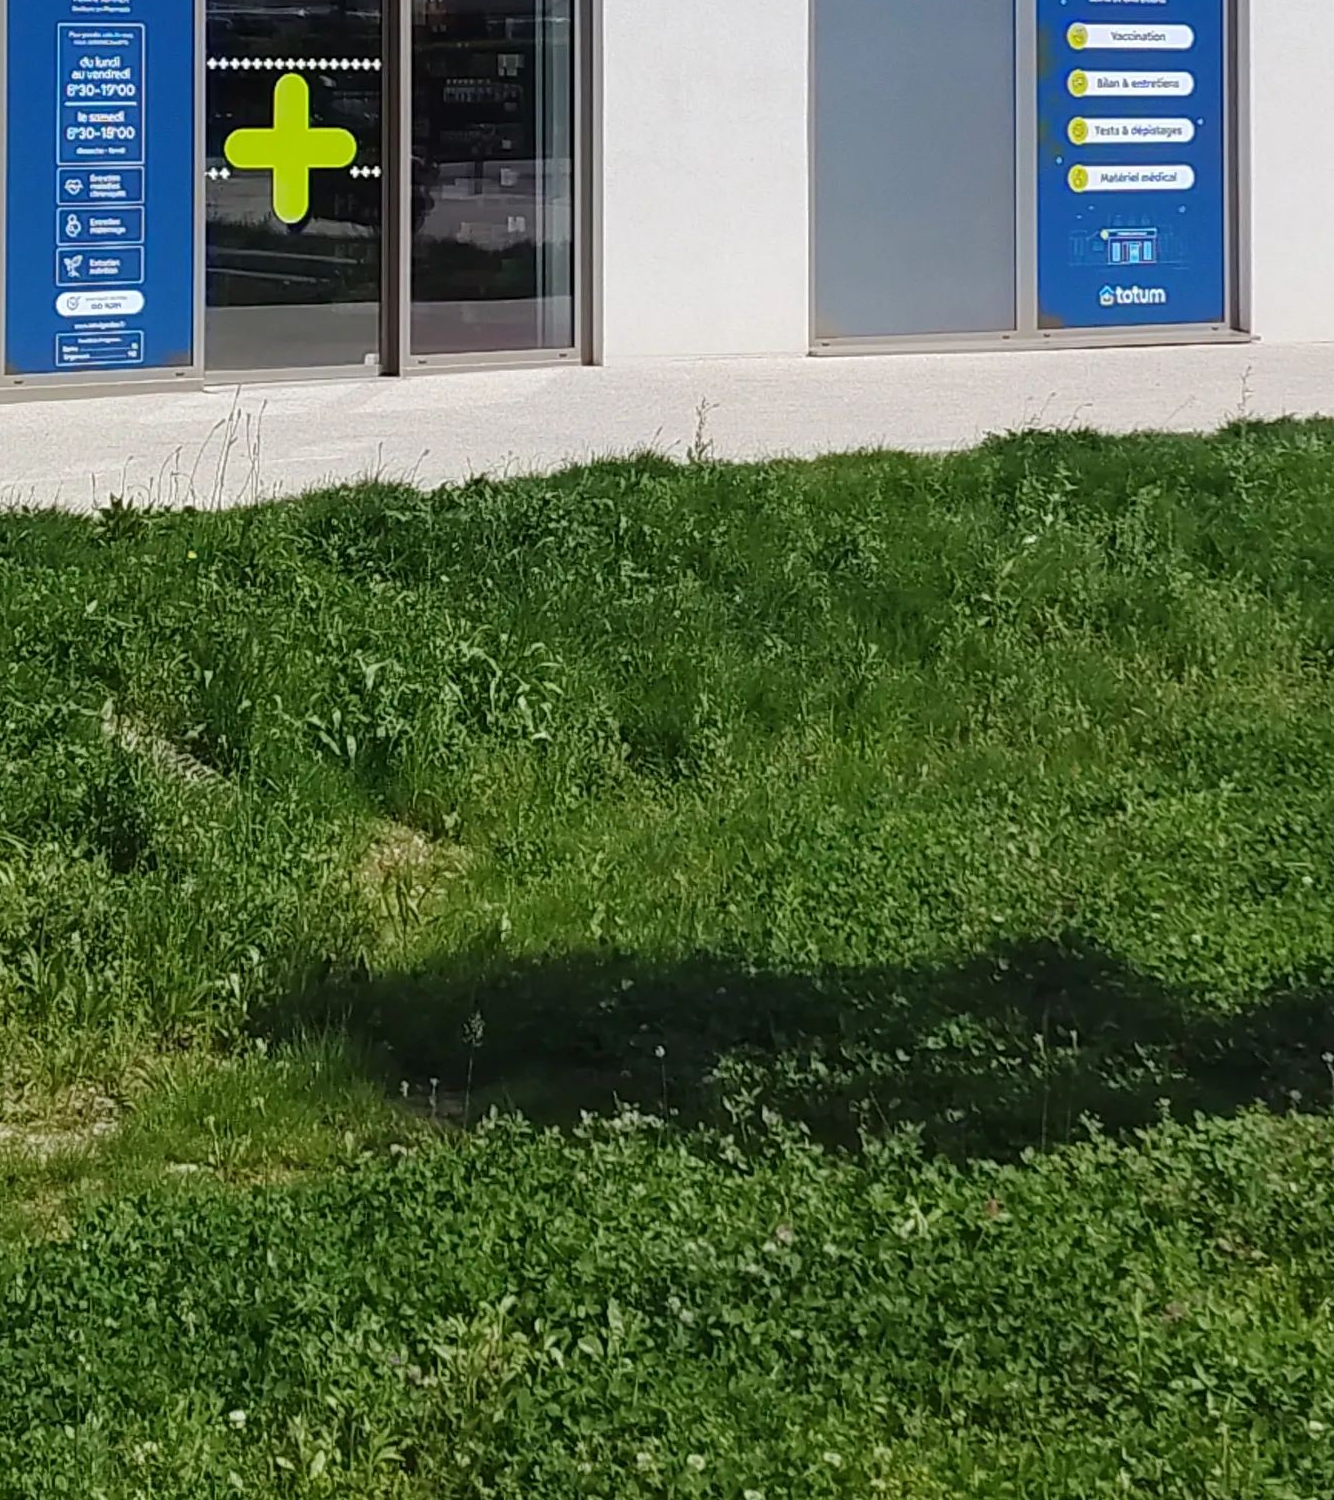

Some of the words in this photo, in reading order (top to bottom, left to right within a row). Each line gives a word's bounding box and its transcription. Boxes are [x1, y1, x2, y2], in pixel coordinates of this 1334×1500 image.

[1110, 30, 1167, 42] Vaccination
[95, 56, 121, 68] lundi
[87, 68, 131, 80] vendredi
[1097, 76, 1120, 88] Bilan
[1131, 77, 1180, 88] entretiens
[1095, 125, 1120, 136] Tests
[1131, 124, 1183, 139] dépistages
[1100, 171, 1140, 183] Matériel
[1141, 171, 1177, 183] médical
[1115, 286, 1167, 305] totum
